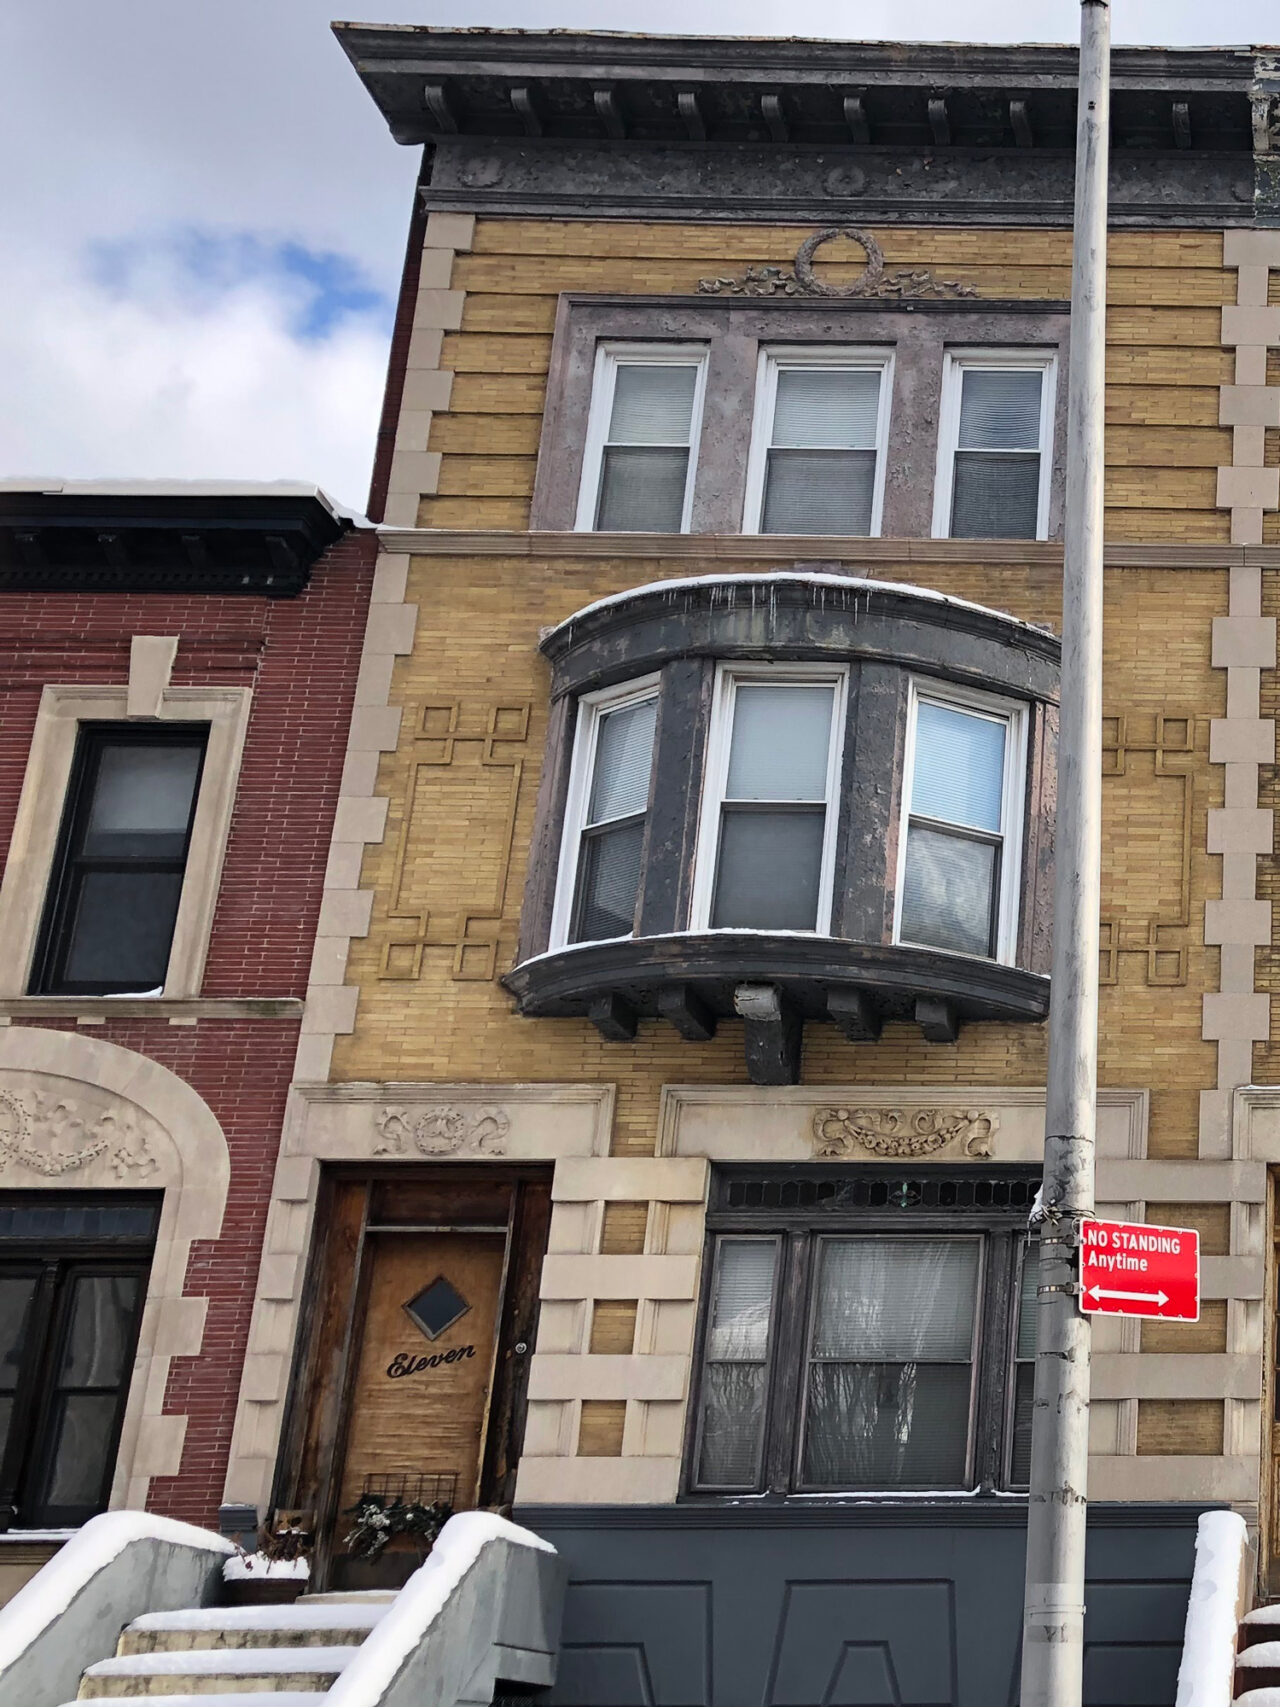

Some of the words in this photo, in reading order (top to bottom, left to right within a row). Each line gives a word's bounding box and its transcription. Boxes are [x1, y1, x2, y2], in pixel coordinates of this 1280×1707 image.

[1088, 1229, 1108, 1247] NO
[1112, 1232, 1181, 1254] STANDING
[1088, 1250, 1148, 1272] Anytime
[387, 1345, 476, 1378] Eleven
